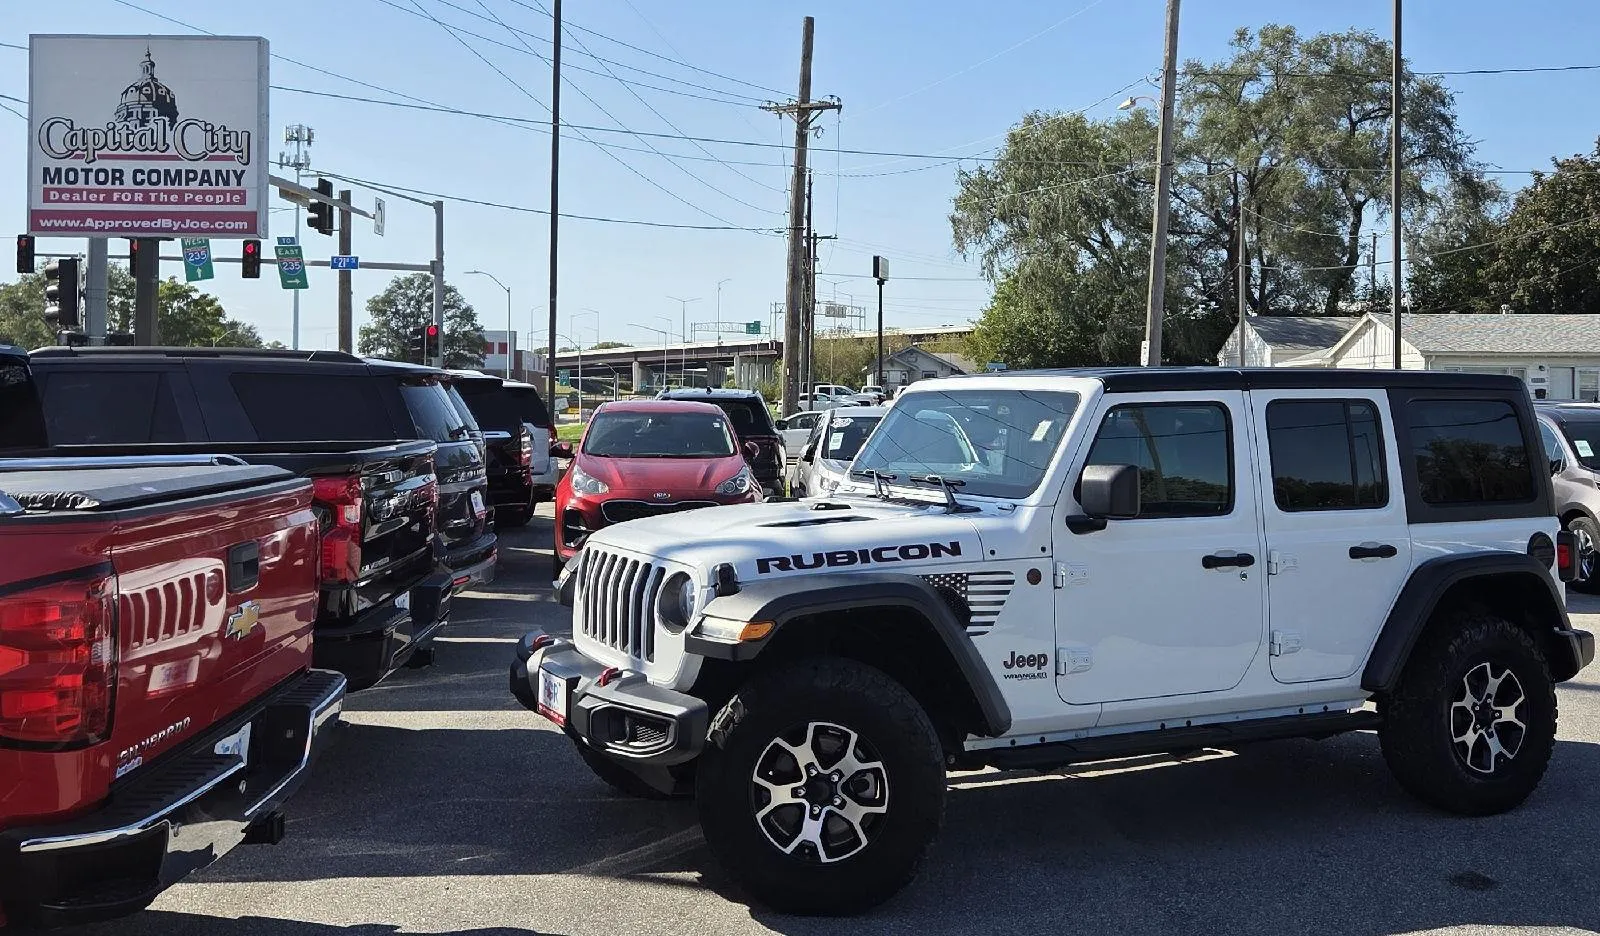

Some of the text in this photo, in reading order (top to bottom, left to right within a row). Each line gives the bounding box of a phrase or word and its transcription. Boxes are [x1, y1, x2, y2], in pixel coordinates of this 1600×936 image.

[38, 116, 251, 166] Capital City
[42, 167, 246, 187] MOTOR COMPANY
[49, 190, 241, 204] Dealer FOR The People
[39, 217, 248, 230] www.ApprovedByJoe.com
[188, 250, 207, 262] 235
[282, 261, 301, 271] 235
[756, 541, 962, 574] RUBICON
[1003, 651, 1048, 670] Jeep
